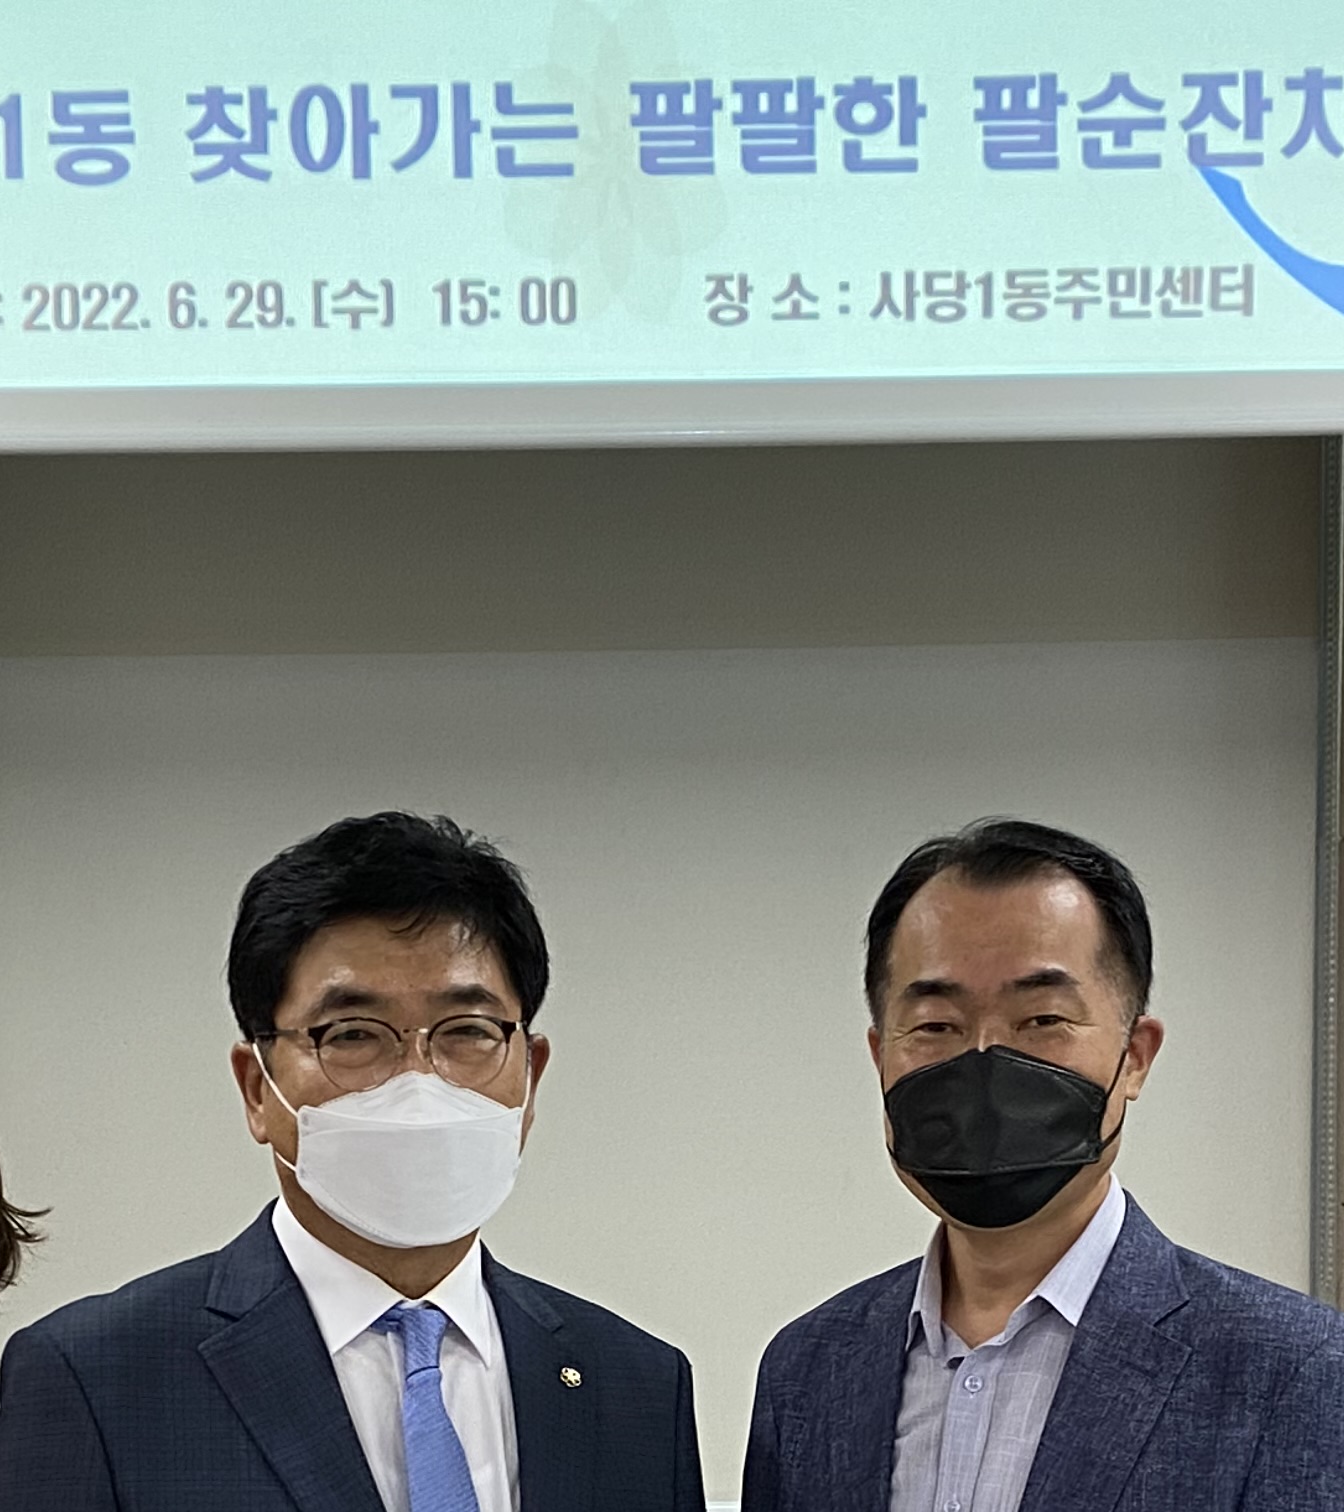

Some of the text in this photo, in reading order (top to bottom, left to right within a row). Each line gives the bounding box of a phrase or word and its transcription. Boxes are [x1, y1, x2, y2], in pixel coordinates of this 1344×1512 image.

[185, 82, 580, 184] 찾아가는
[628, 75, 928, 177] 팔팔한
[21, 281, 151, 332] 2022.
[167, 281, 209, 330] 6.
[224, 279, 296, 329] 29.
[519, 276, 578, 327] 00
[704, 272, 755, 327] 장
[770, 272, 820, 322] 소
[868, 263, 1255, 324] 사당1동주민센터
